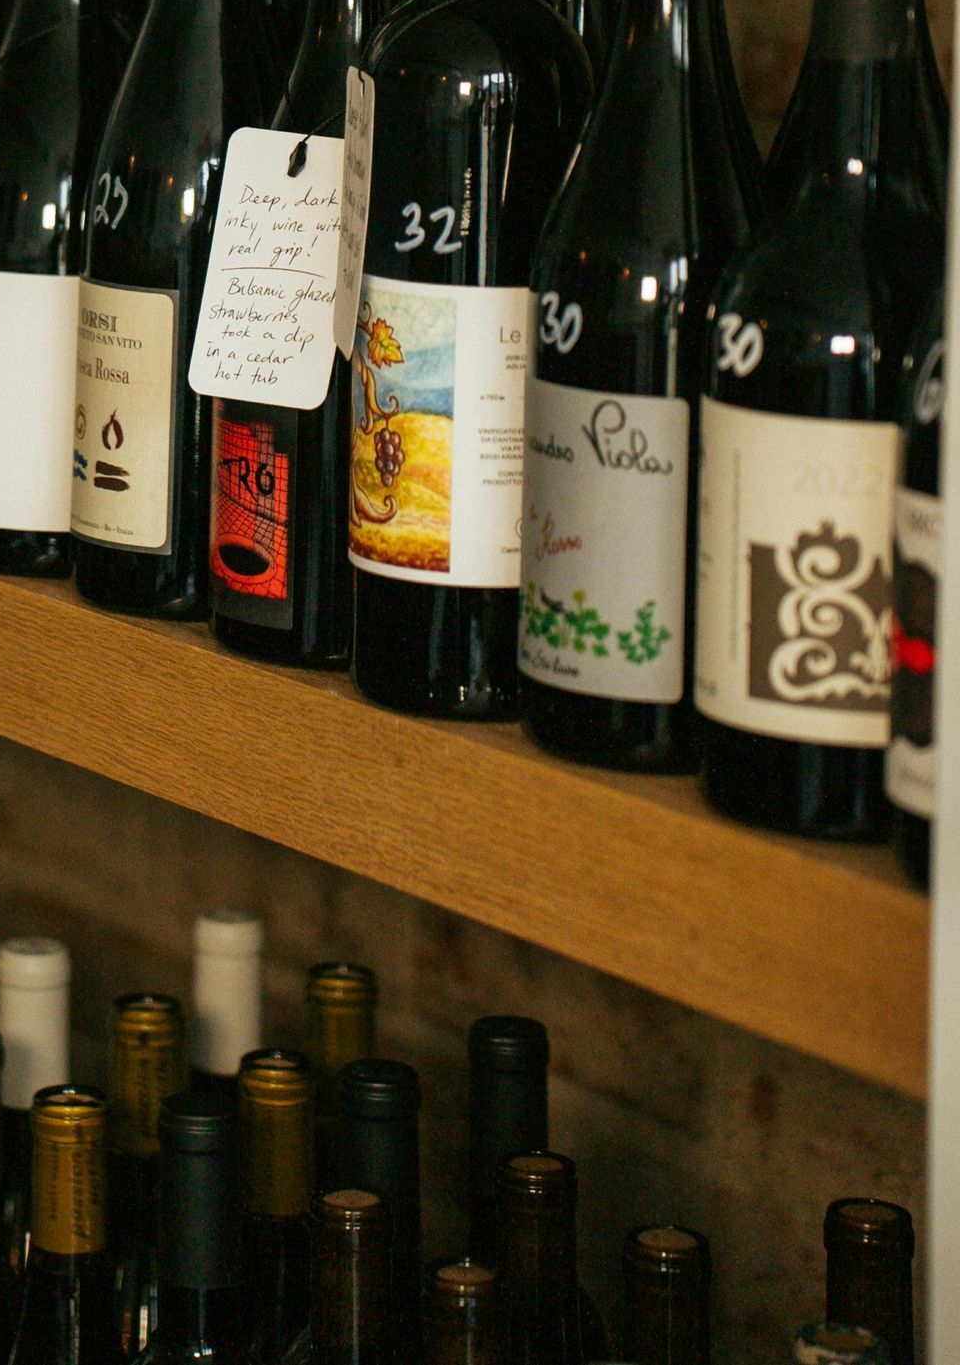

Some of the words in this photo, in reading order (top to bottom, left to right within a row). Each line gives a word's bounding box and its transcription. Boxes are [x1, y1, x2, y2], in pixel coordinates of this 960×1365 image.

[239, 184, 288, 210] Deep,
[293, 187, 339, 208] dark
[224, 211, 258, 236] inky
[272, 220, 305, 234] wine
[395, 201, 462, 255] 32
[228, 237, 259, 257] real
[273, 236, 318, 267] grip!
[228, 277, 286, 300] Balsamic
[290, 280, 337, 311] glazed
[81, 308, 118, 333] ORSI
[541, 291, 583, 355] 30
[96, 333, 115, 346] SAN
[116, 337, 142, 351] VITO
[221, 324, 251, 338] took
[263, 331, 276, 340] a
[284, 328, 315, 353] dip
[717, 311, 764, 378] 30
[205, 341, 220, 358] in
[228, 351, 237, 360] a
[246, 349, 294, 365] cedar
[95, 357, 130, 384] Rossa
[214, 362, 243, 379] hot
[251, 368, 279, 385] tub
